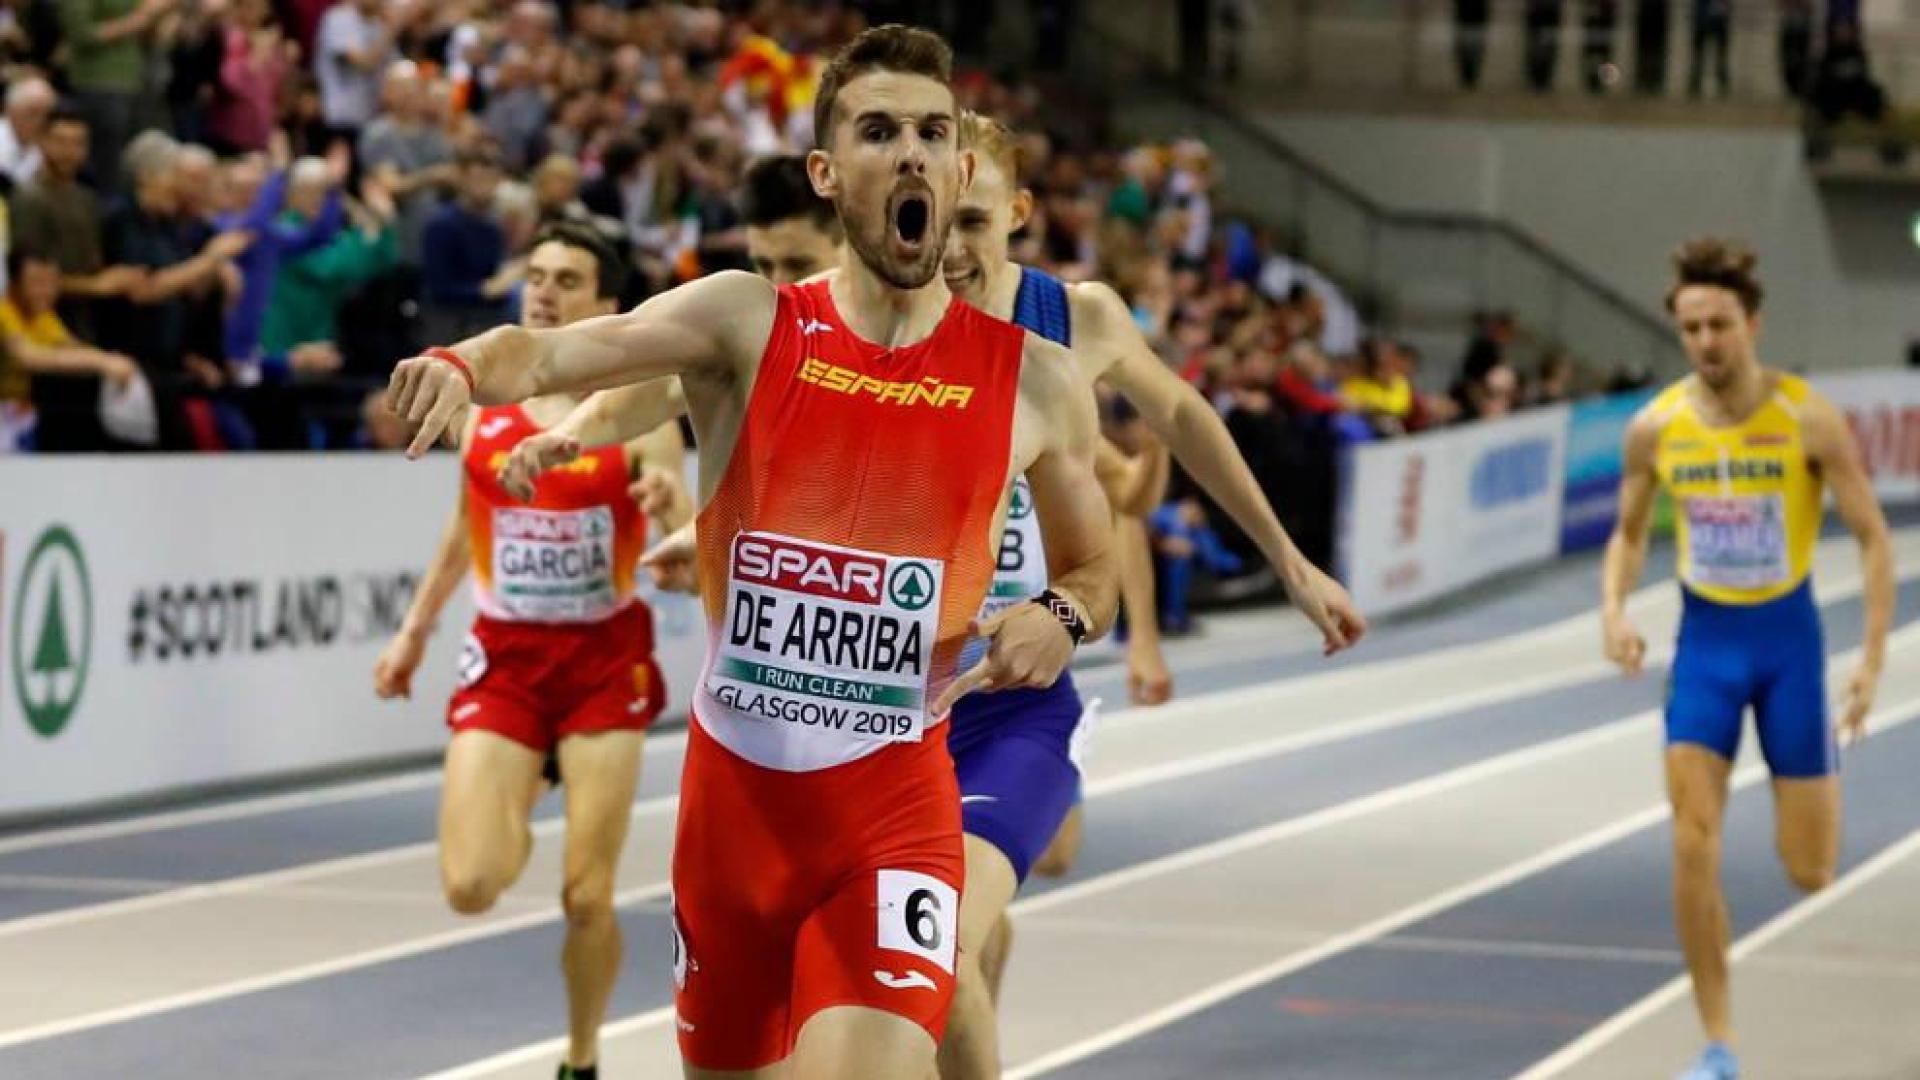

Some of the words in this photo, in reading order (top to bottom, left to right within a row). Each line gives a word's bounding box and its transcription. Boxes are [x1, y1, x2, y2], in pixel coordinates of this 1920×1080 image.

[797, 356, 975, 410] ESPAÑA
[501, 541, 607, 579] GARCIA
[737, 541, 881, 598] SPAR
[730, 589, 777, 653] DE
[780, 602, 922, 676] ARRIBA
[756, 666, 763, 681] I
[765, 668, 804, 690] RUN
[716, 684, 849, 730] GLASGOW
[852, 710, 913, 736] 2019
[904, 887, 942, 951] 6
